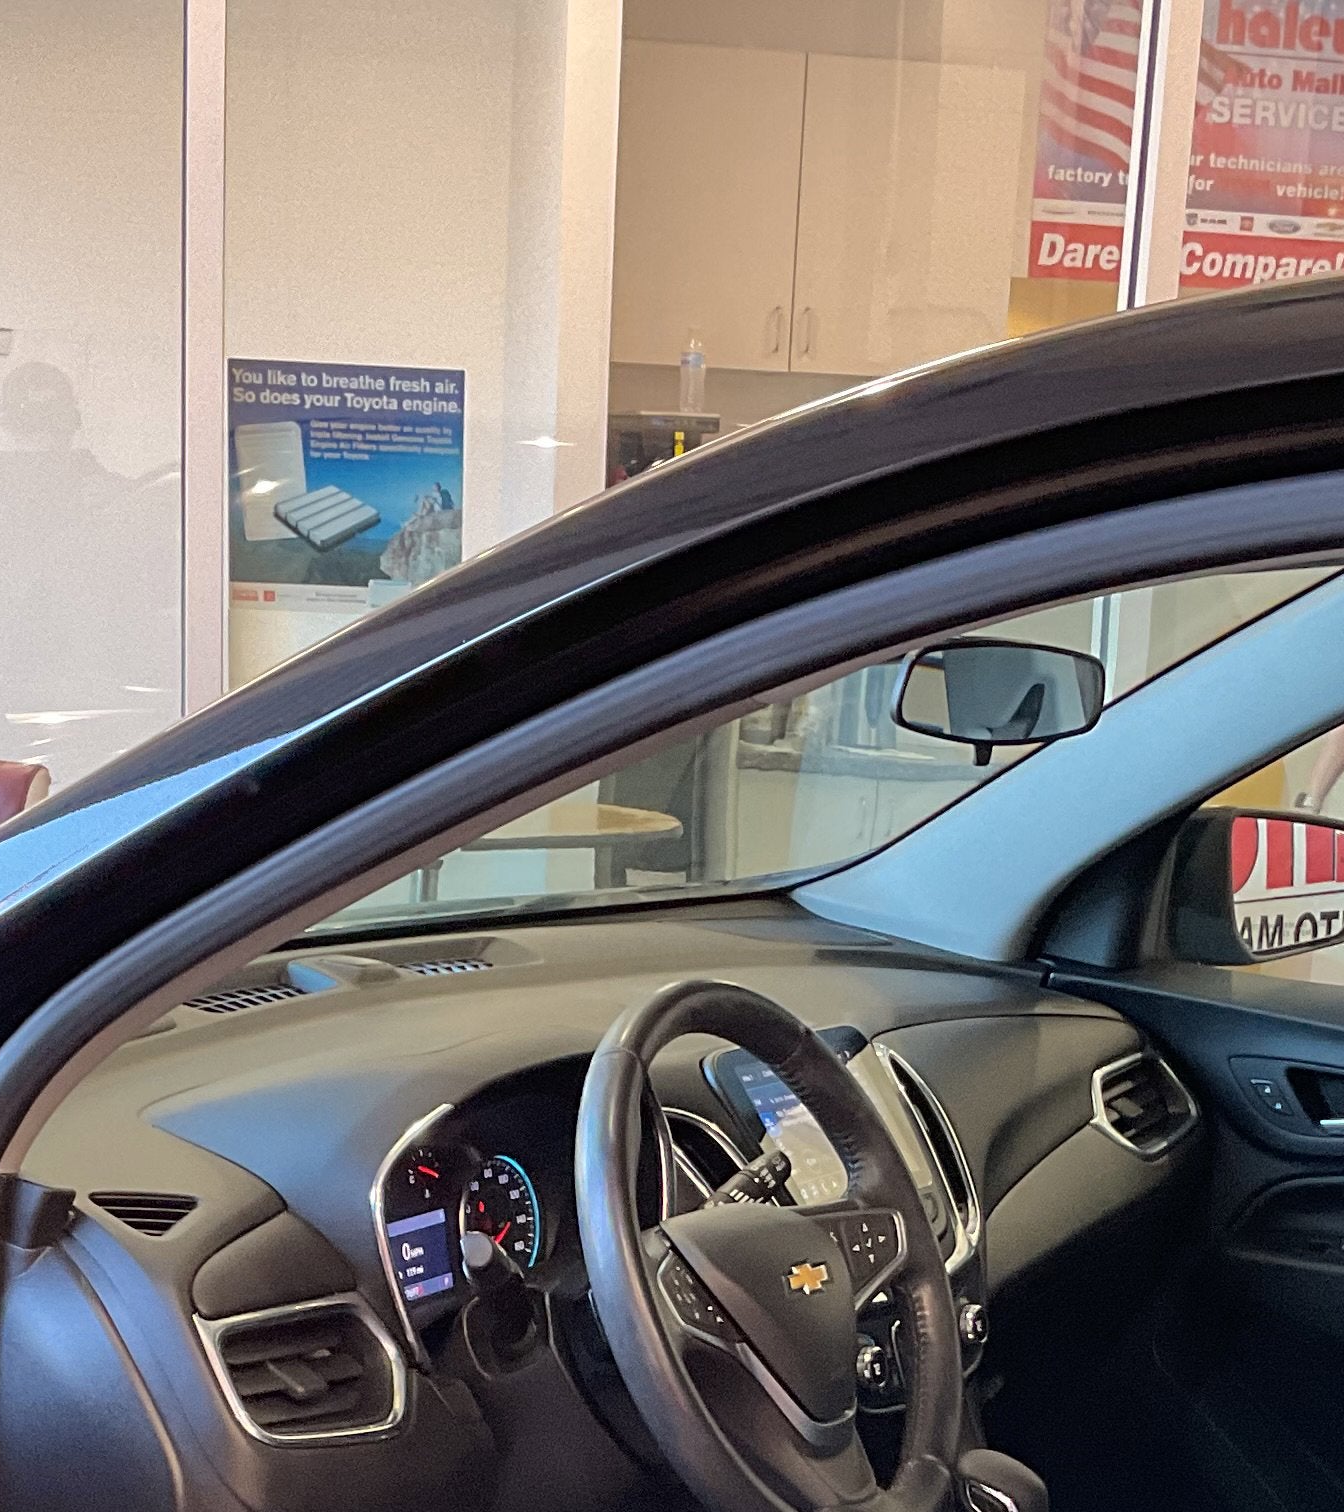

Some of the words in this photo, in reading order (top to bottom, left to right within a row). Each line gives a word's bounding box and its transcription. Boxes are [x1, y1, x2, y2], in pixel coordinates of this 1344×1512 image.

[1224, 67, 1283, 91] Auto
[1047, 164, 1112, 187] factory
[1209, 152, 1313, 175] technicians
[1188, 174, 1215, 194] for
[1275, 183, 1344, 201] vehicle!
[1037, 232, 1120, 270] Dare
[231, 367, 263, 385] You
[267, 370, 297, 387] like
[301, 372, 318, 388] to
[322, 372, 385, 391] breathe
[389, 375, 430, 394] fresh
[434, 378, 459, 395] air.
[232, 387, 256, 404] So
[259, 388, 301, 406] does
[303, 393, 340, 410] your
[344, 393, 398, 412] Toyota
[402, 397, 462, 415] engine.
